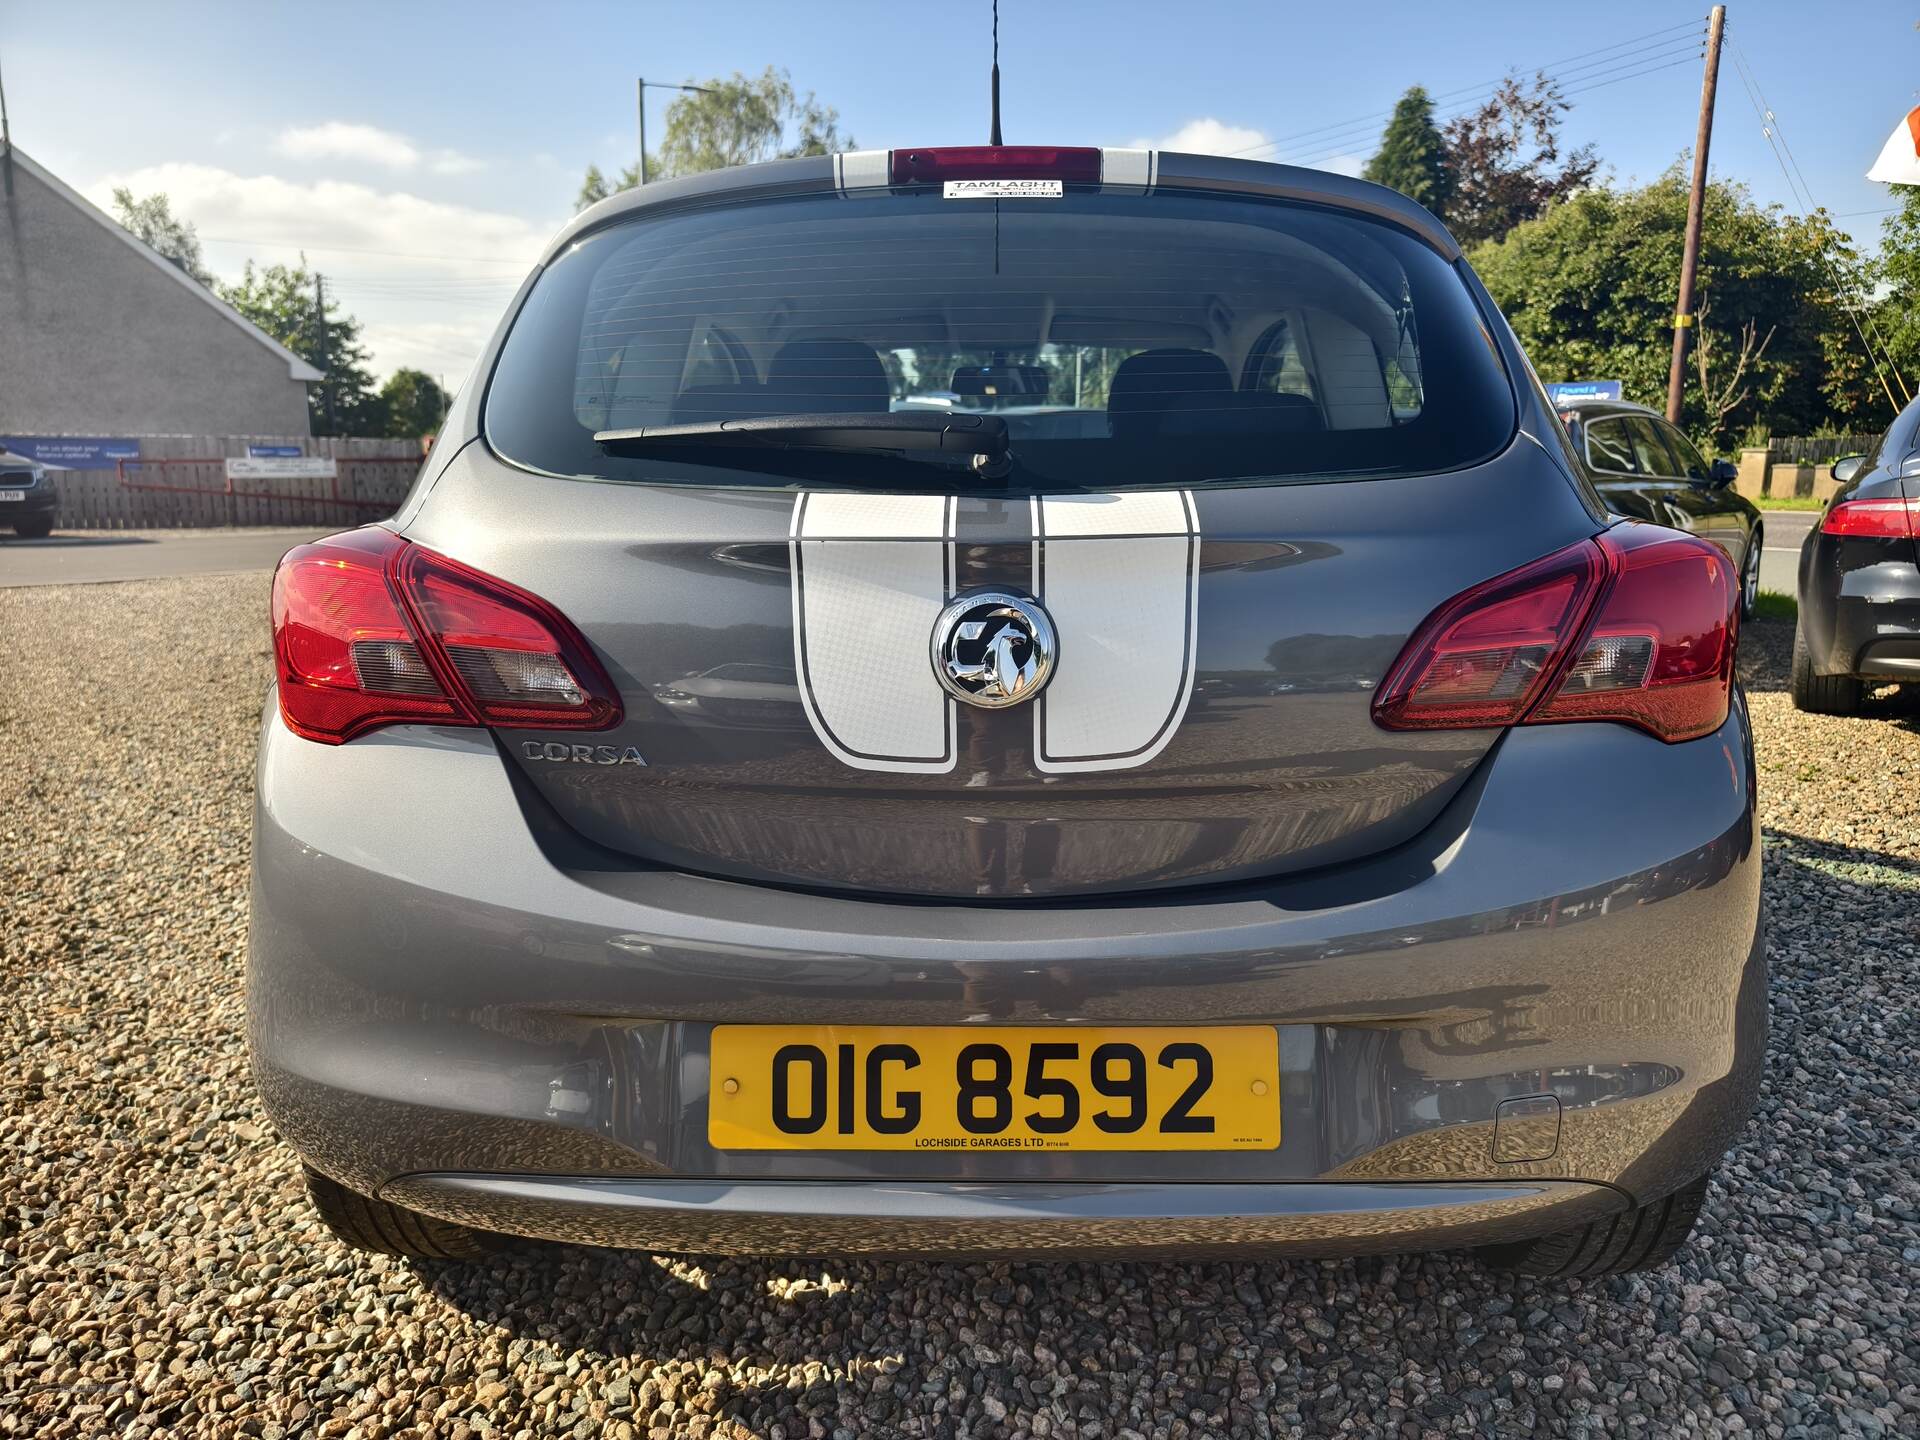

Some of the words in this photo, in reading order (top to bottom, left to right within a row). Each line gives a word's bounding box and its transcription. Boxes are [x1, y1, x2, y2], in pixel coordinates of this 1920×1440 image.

[522, 741, 648, 767] CORSA
[772, 1043, 921, 1134] OIG
[956, 1043, 1215, 1133] 8592
[915, 1138, 967, 1147] LOCHSIDE
[970, 1138, 1021, 1147] GARAGES
[1024, 1138, 1044, 1147] LTD
